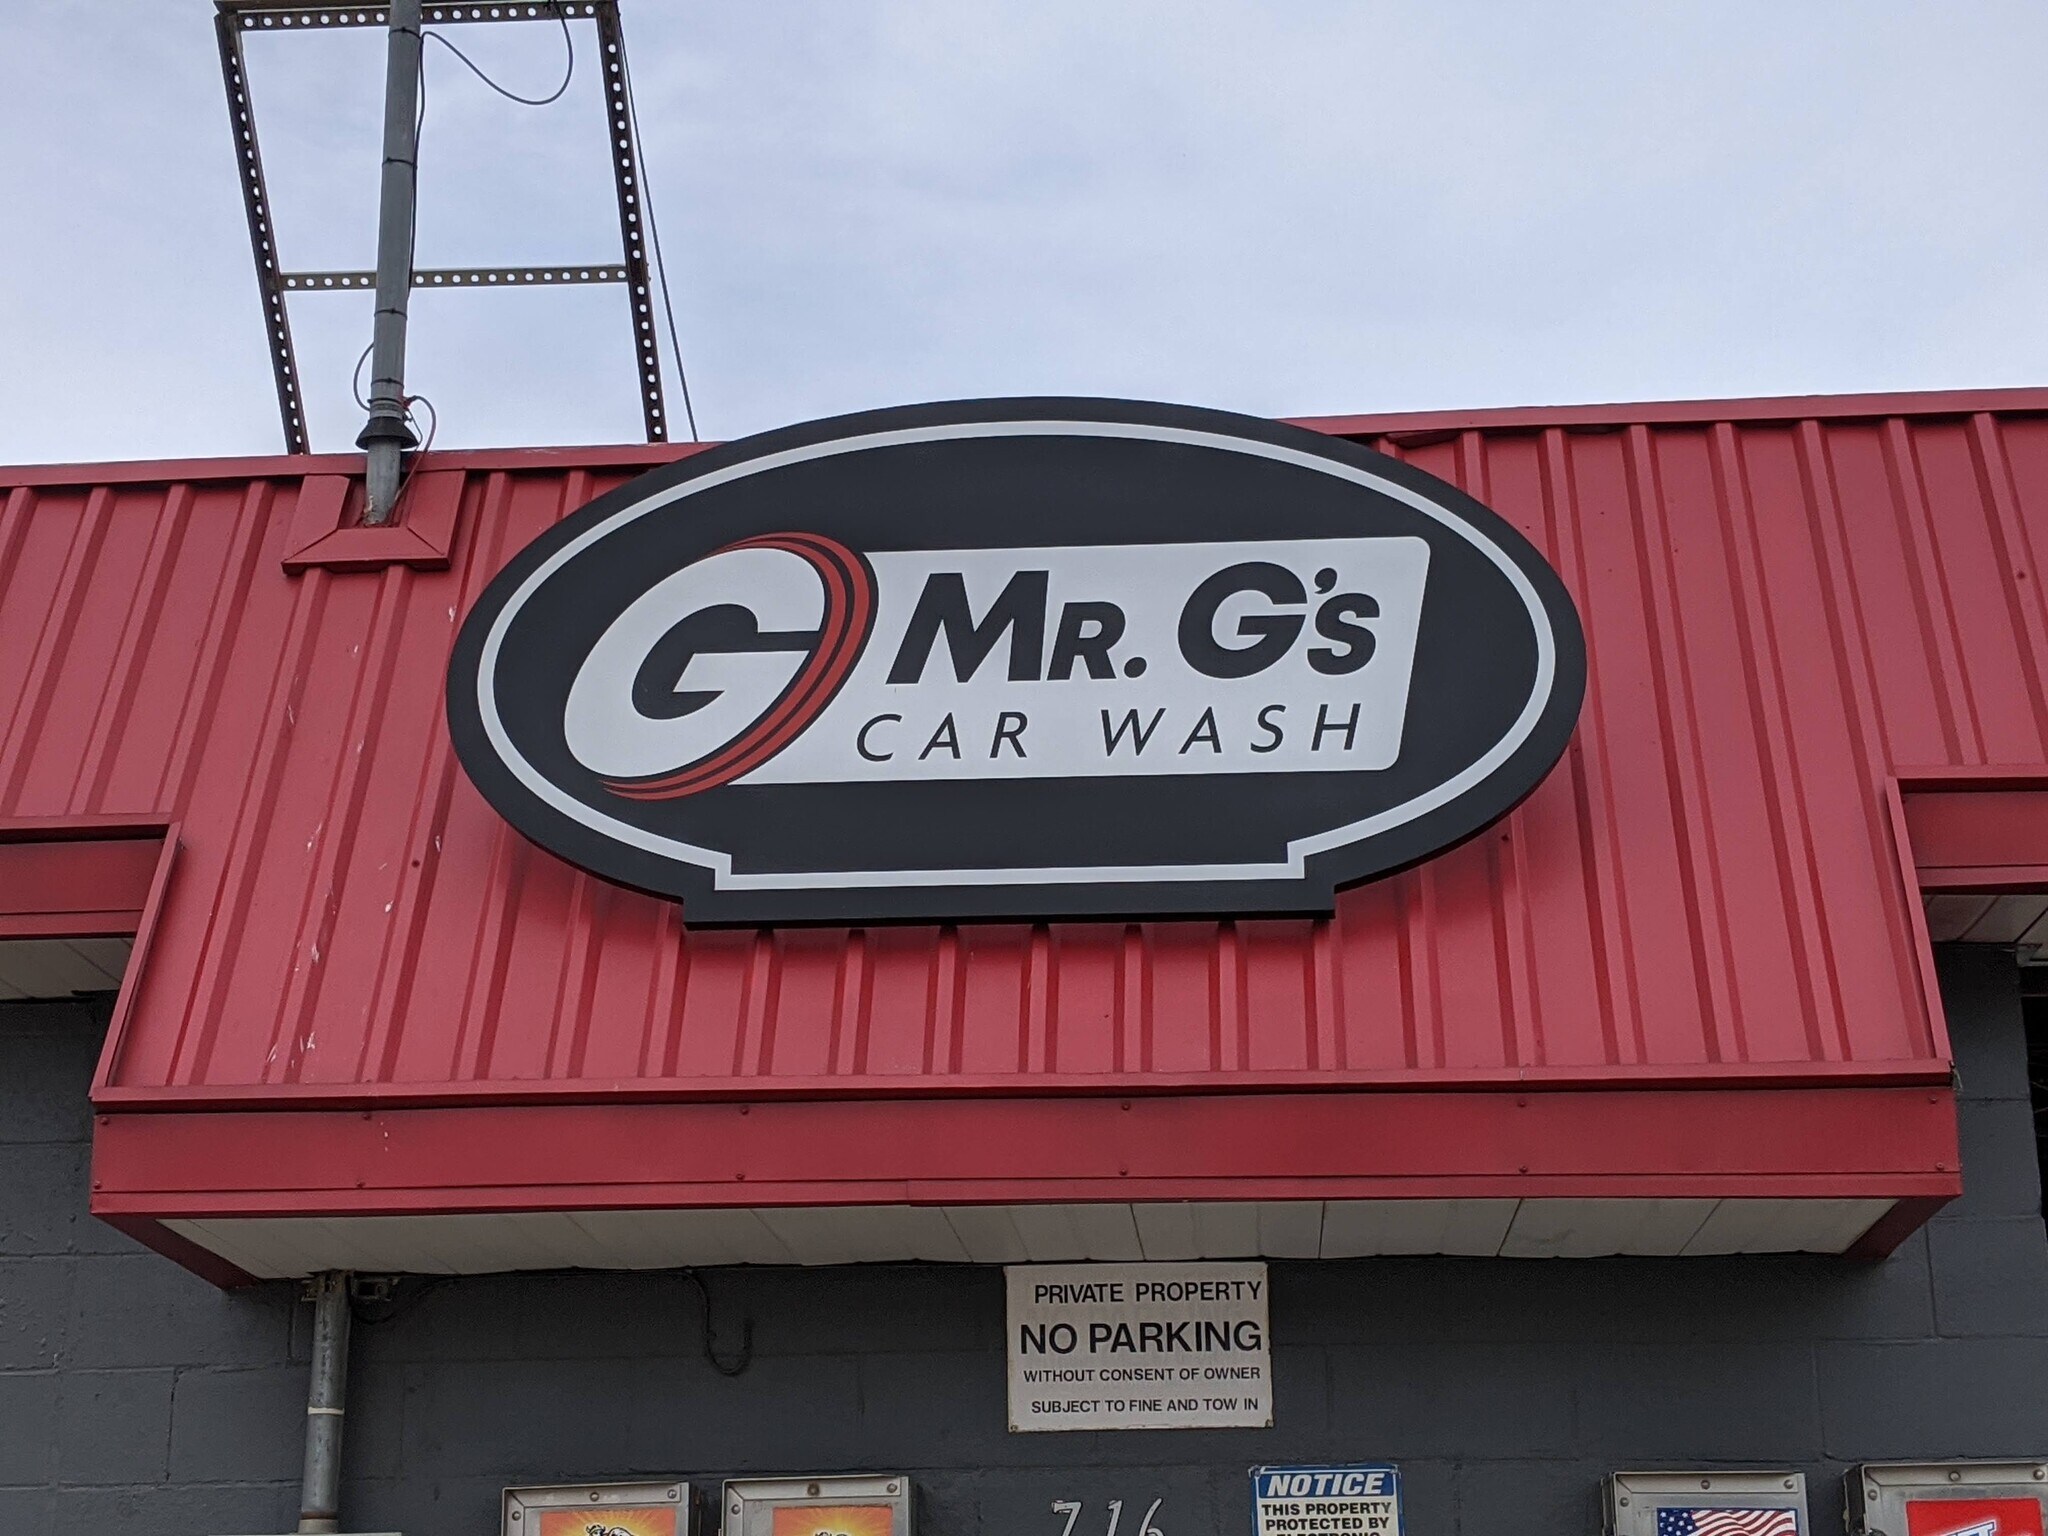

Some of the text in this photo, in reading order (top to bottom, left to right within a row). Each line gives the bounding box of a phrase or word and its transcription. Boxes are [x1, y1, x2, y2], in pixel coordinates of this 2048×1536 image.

[857, 703, 1361, 762] CAR WASH
[1034, 1281, 1262, 1304] PRIVATE PROPERTY
[1020, 1320, 1262, 1354] NO PARKING
[1023, 1366, 1261, 1383] WITHOUT CONSENT OF OWNER
[1031, 1398, 1259, 1414] SUBJECT TO FINE AND TOW IN
[1266, 1472, 1386, 1497] NOTICE
[1261, 1501, 1392, 1516] THIS PROPERTY
[1265, 1516, 1390, 1531] PROTECTED BY
